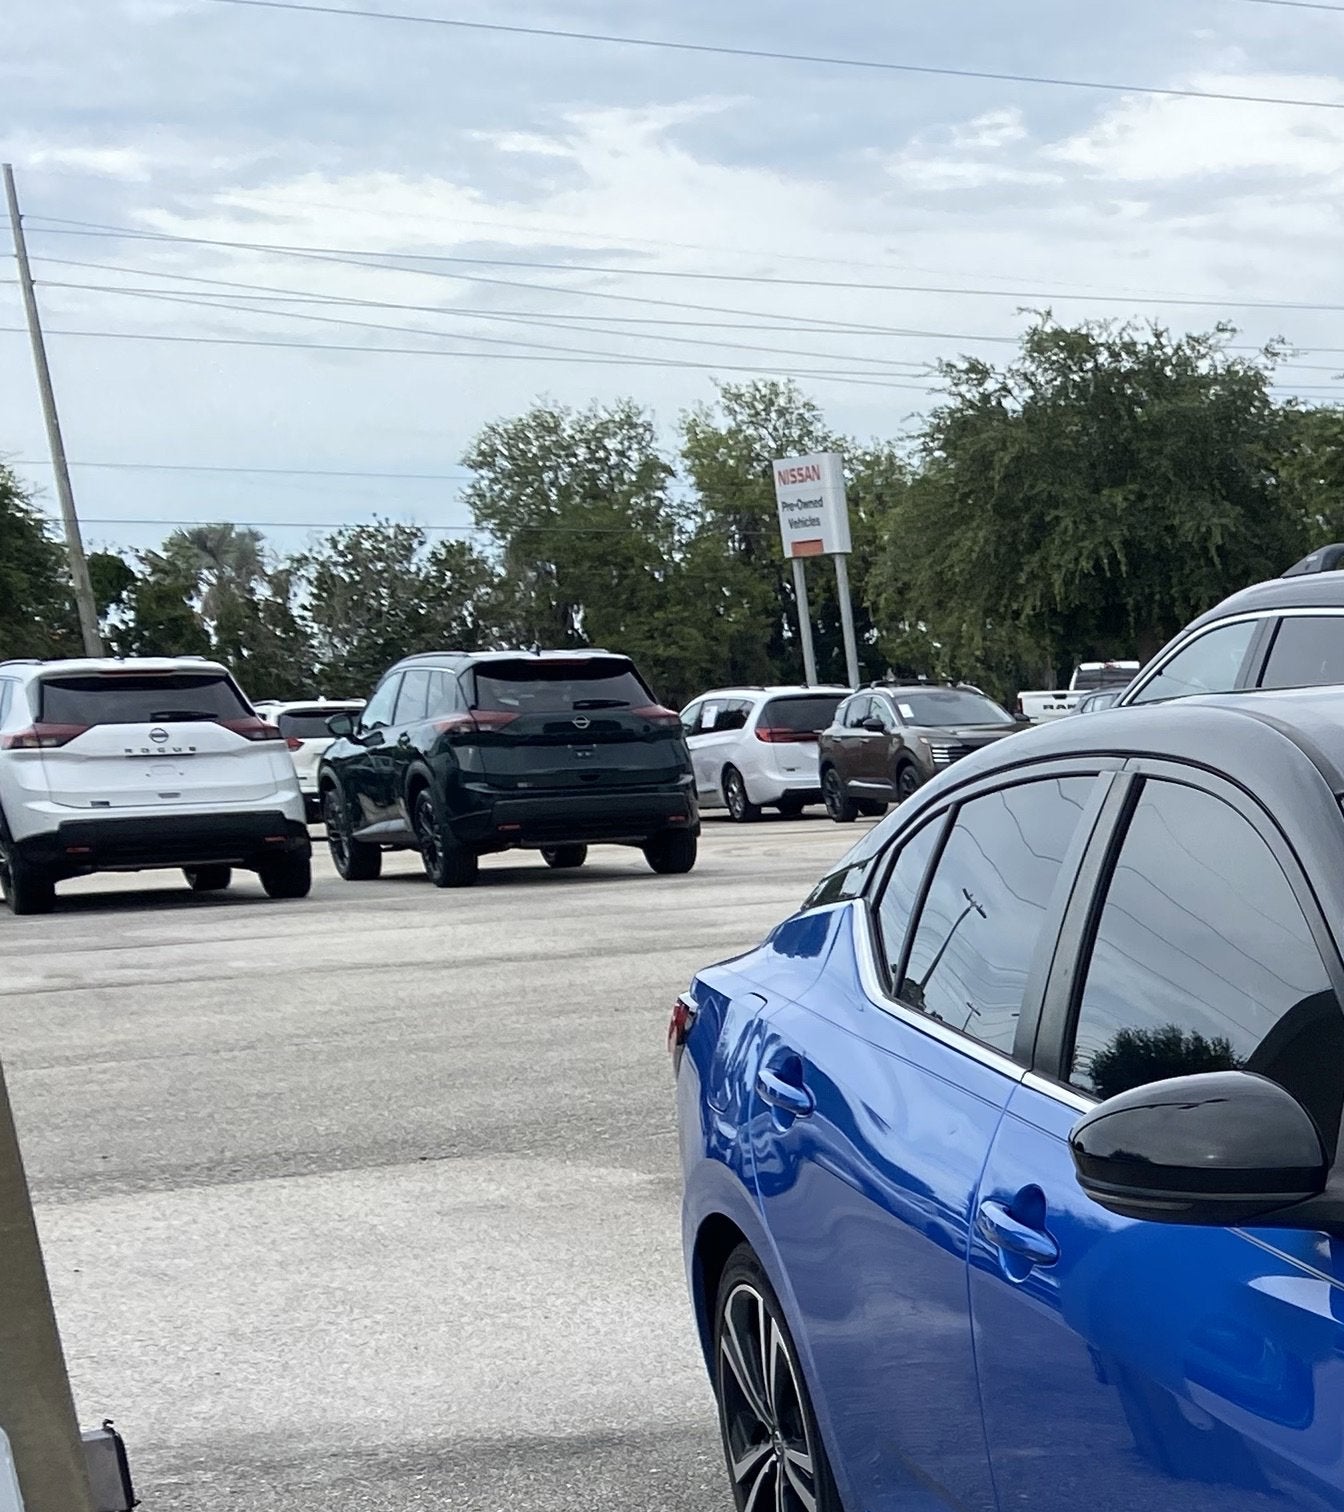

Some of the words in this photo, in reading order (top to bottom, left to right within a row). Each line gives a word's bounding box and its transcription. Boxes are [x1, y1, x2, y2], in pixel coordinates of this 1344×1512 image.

[778, 464, 820, 486] NISSAN
[781, 496, 823, 512] Pre-Owned
[788, 516, 821, 530] Vehicles
